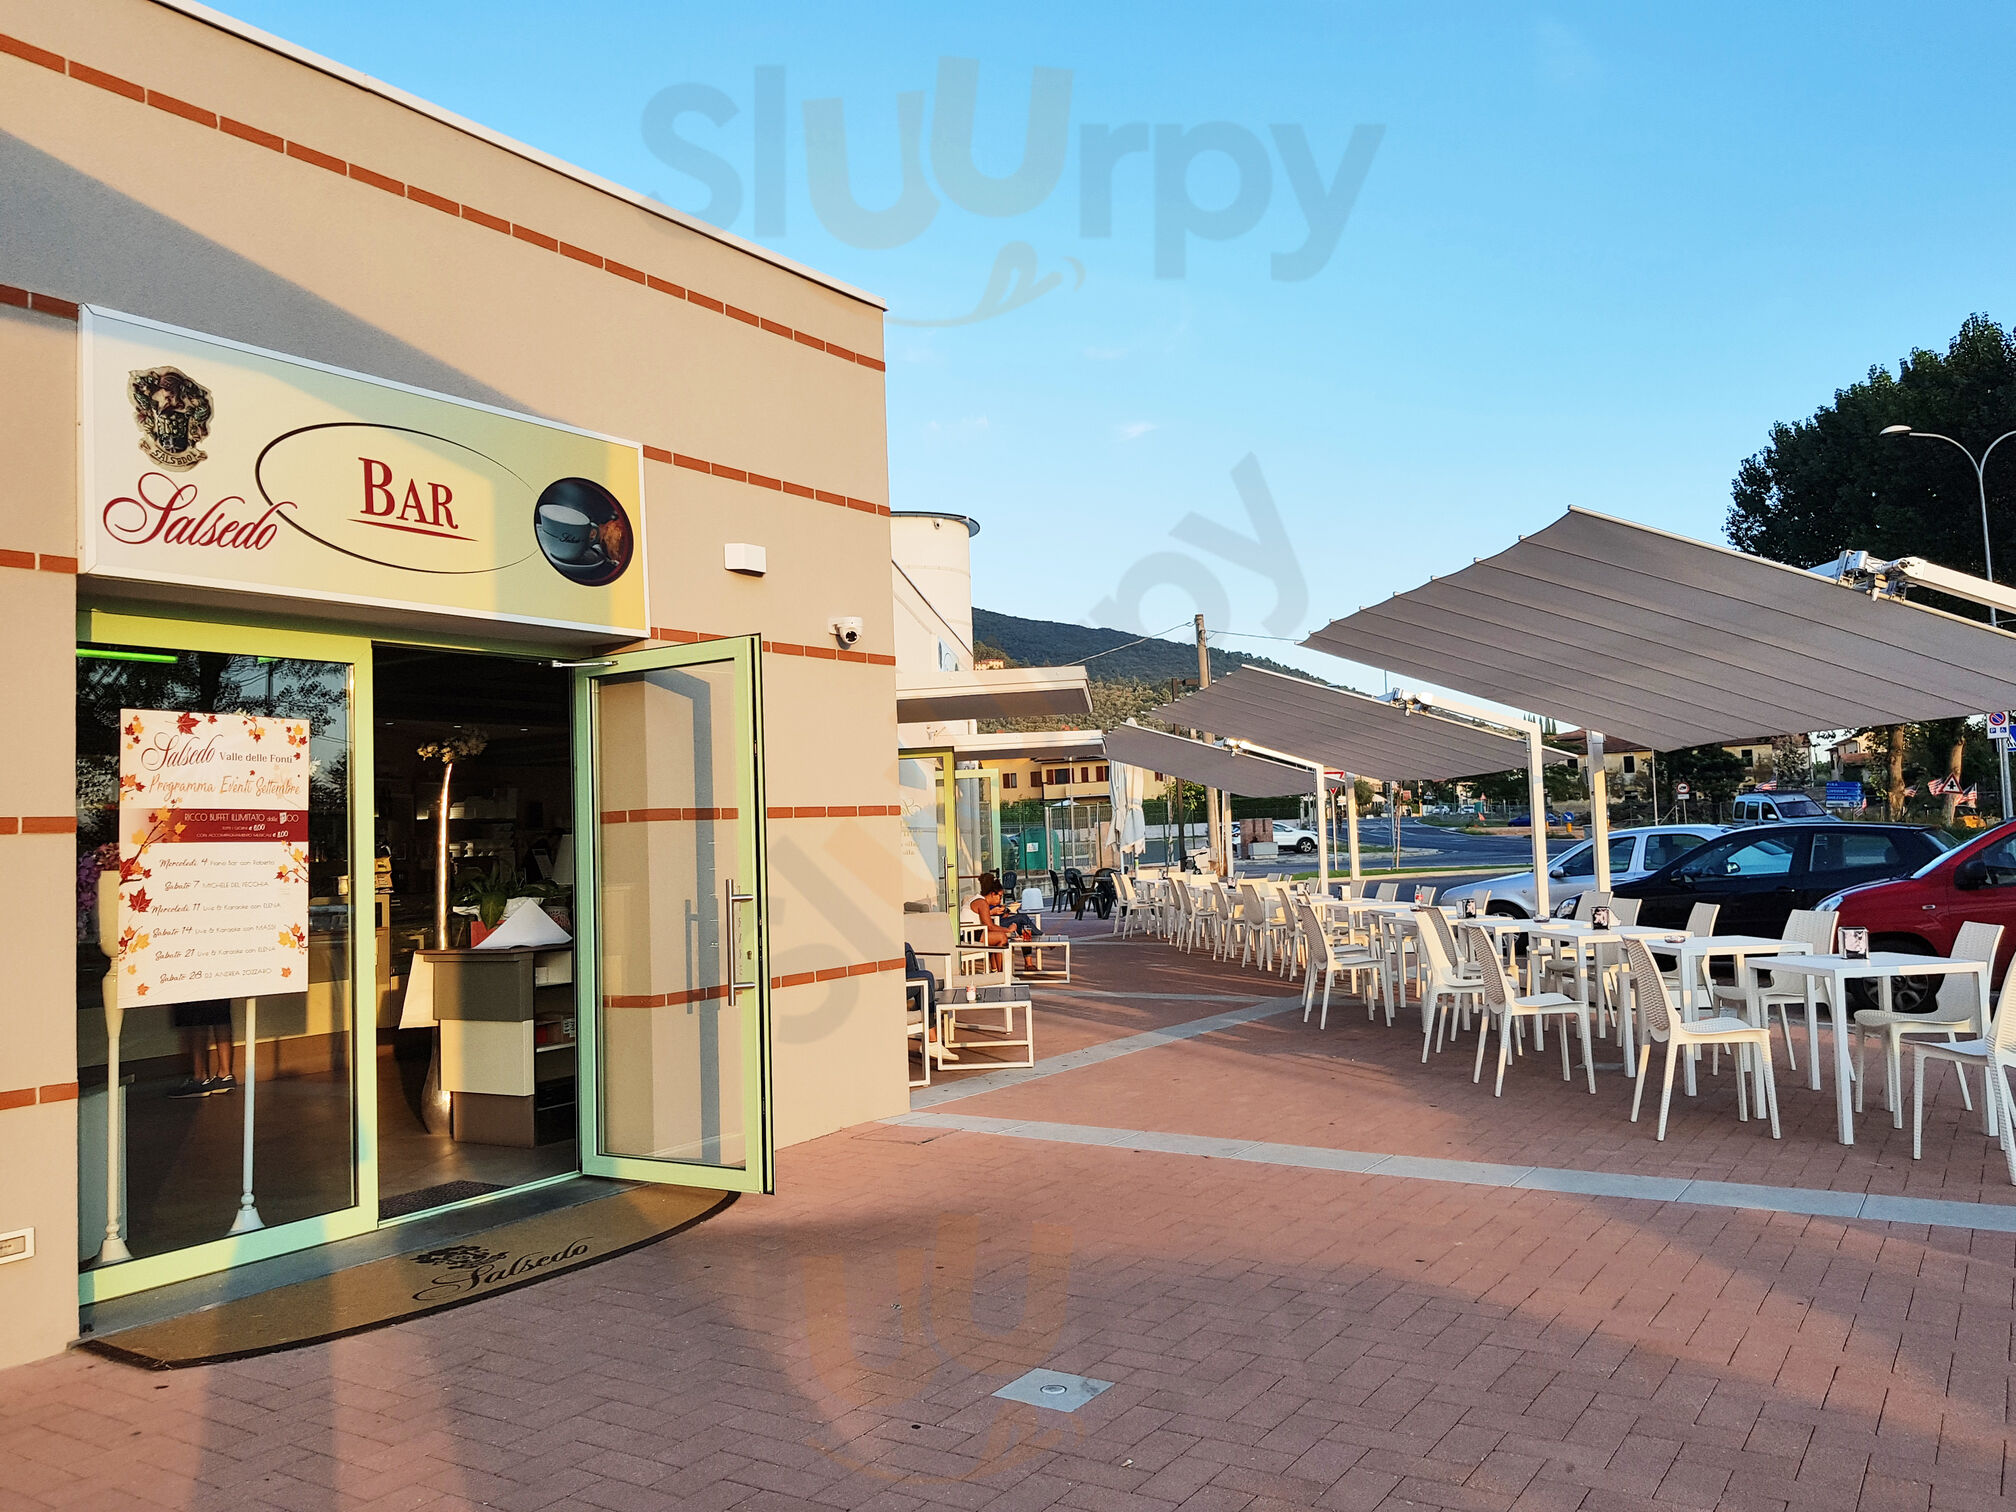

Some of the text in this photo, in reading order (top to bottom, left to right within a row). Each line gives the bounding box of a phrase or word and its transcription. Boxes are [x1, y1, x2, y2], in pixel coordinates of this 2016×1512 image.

[102, 471, 298, 552] Salsedo
[141, 731, 293, 771] Salsedo Valle delle Fonti
[149, 773, 301, 802] Programma Eventi Settembre
[184, 812, 208, 822] RICCO
[209, 813, 229, 822] BUFFET
[231, 813, 266, 823] ILLIMITATO
[201, 858, 208, 867] 4
[165, 881, 191, 891] Sabato
[193, 880, 200, 888] 7
[193, 903, 201, 912] 11
[152, 927, 179, 939] Sabato
[182, 926, 193, 935] 14
[155, 950, 182, 961] Sabato
[184, 949, 195, 958] 21
[159, 973, 187, 984] Sabato
[189, 970, 203, 980] 28
[412, 1236, 595, 1301] Salsedo
